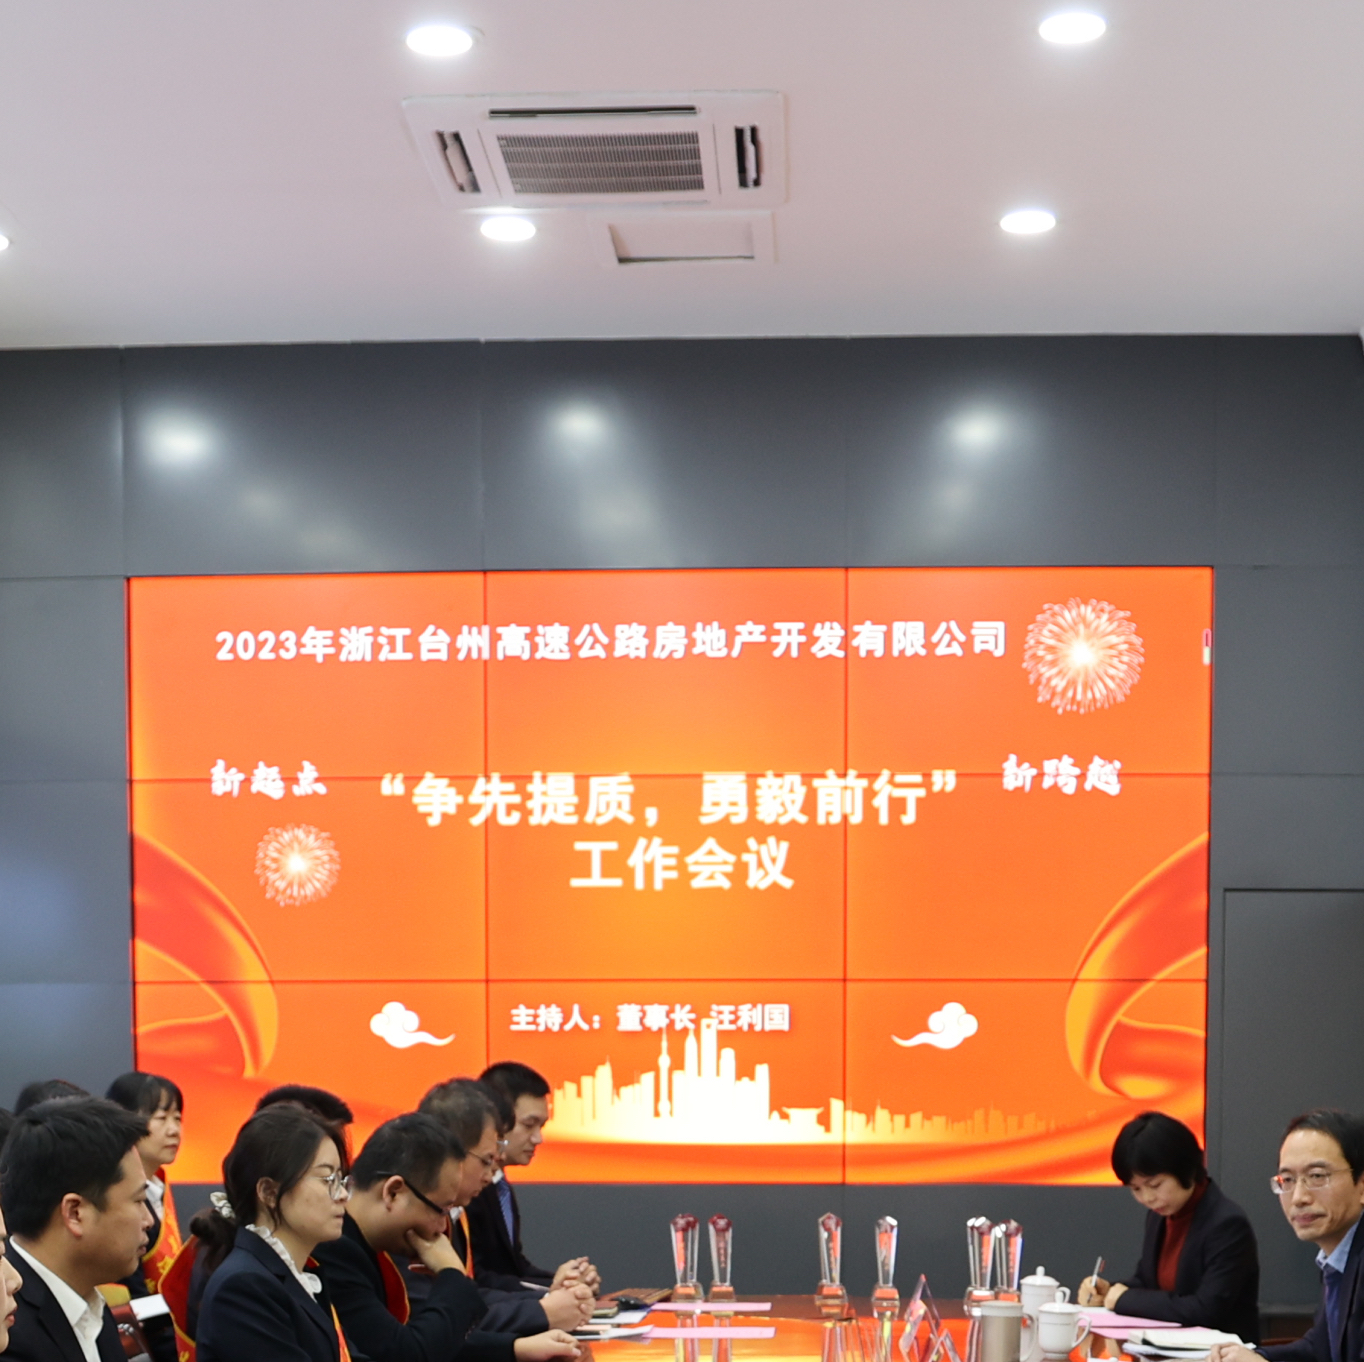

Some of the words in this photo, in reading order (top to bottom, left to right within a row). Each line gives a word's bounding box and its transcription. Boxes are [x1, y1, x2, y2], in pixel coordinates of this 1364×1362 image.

[214, 618, 1007, 665] 2023年浙江台州高速公路房地产开发有限公司
[209, 758, 328, 801] 新起点
[379, 768, 958, 828] “争先提质，勇毅前行”
[1001, 753, 1122, 797] 新跨越
[569, 836, 795, 891] 工作会议
